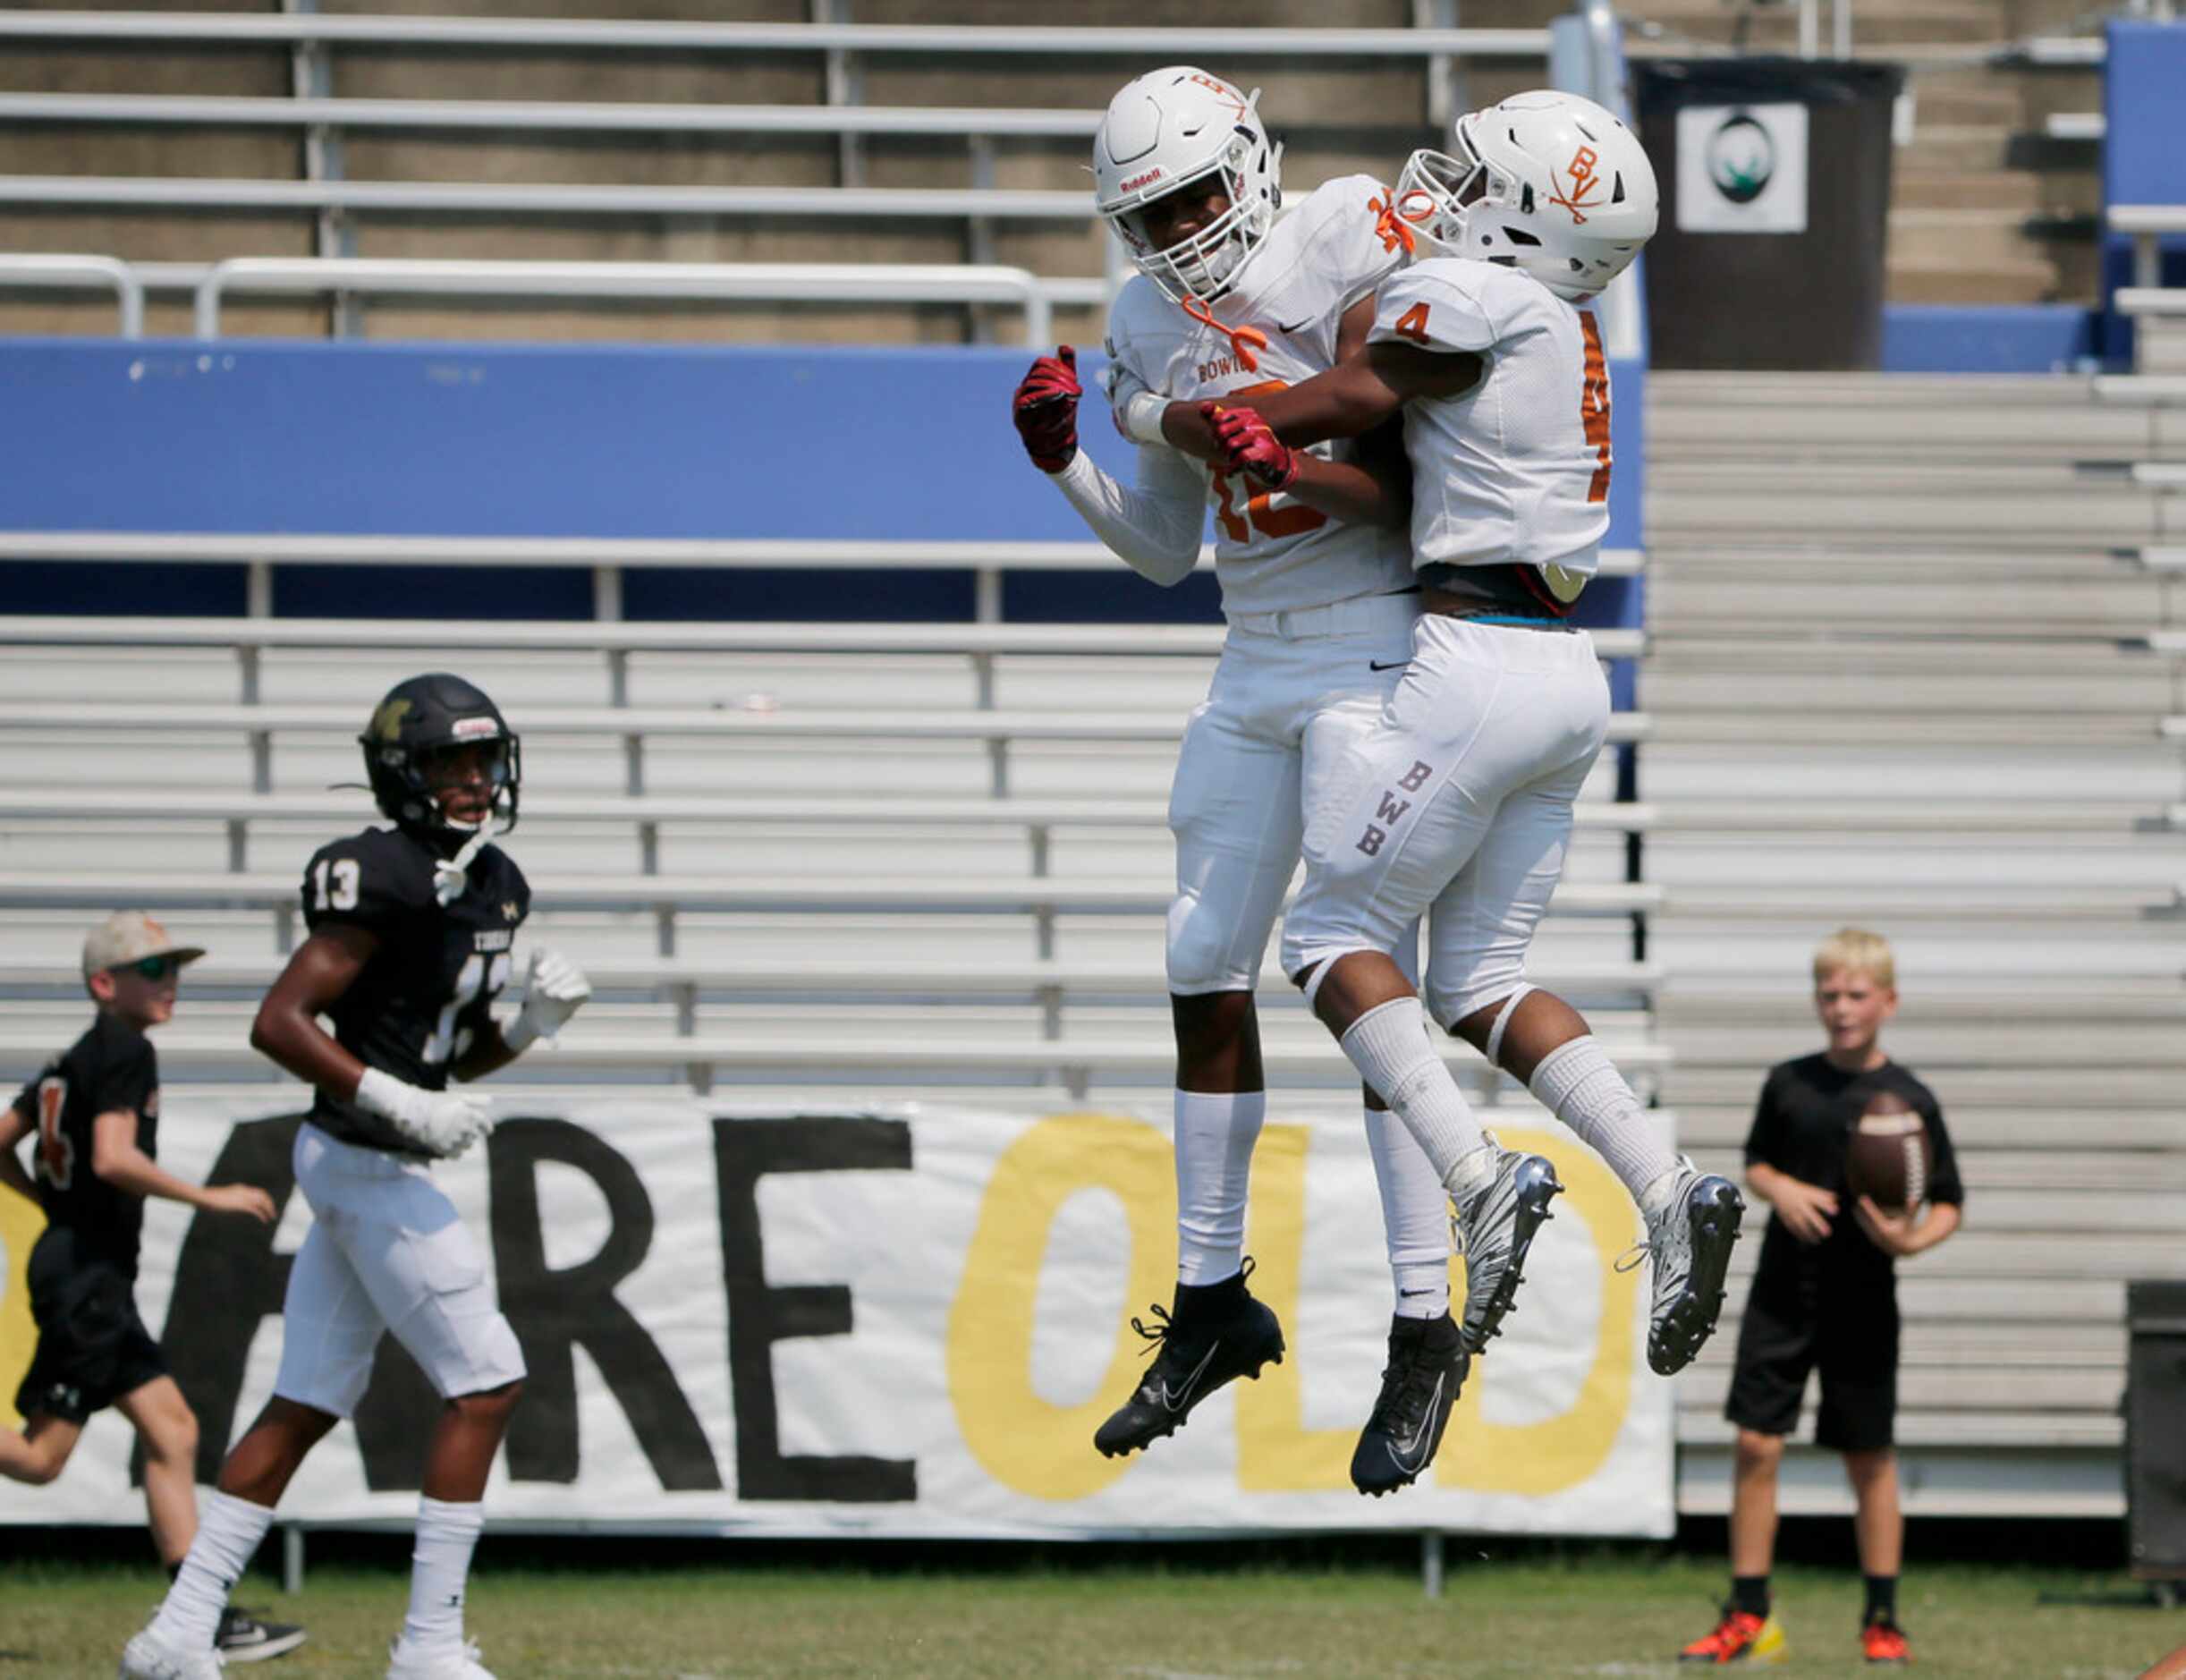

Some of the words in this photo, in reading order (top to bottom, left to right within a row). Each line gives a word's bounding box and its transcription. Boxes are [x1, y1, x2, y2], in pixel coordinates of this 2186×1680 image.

[1120, 167, 1160, 192] Riddell
[1395, 301, 1431, 345] 4
[314, 859, 360, 911] 13
[131, 1115, 917, 1501] ARE
[945, 1112, 1639, 1500] OLD
